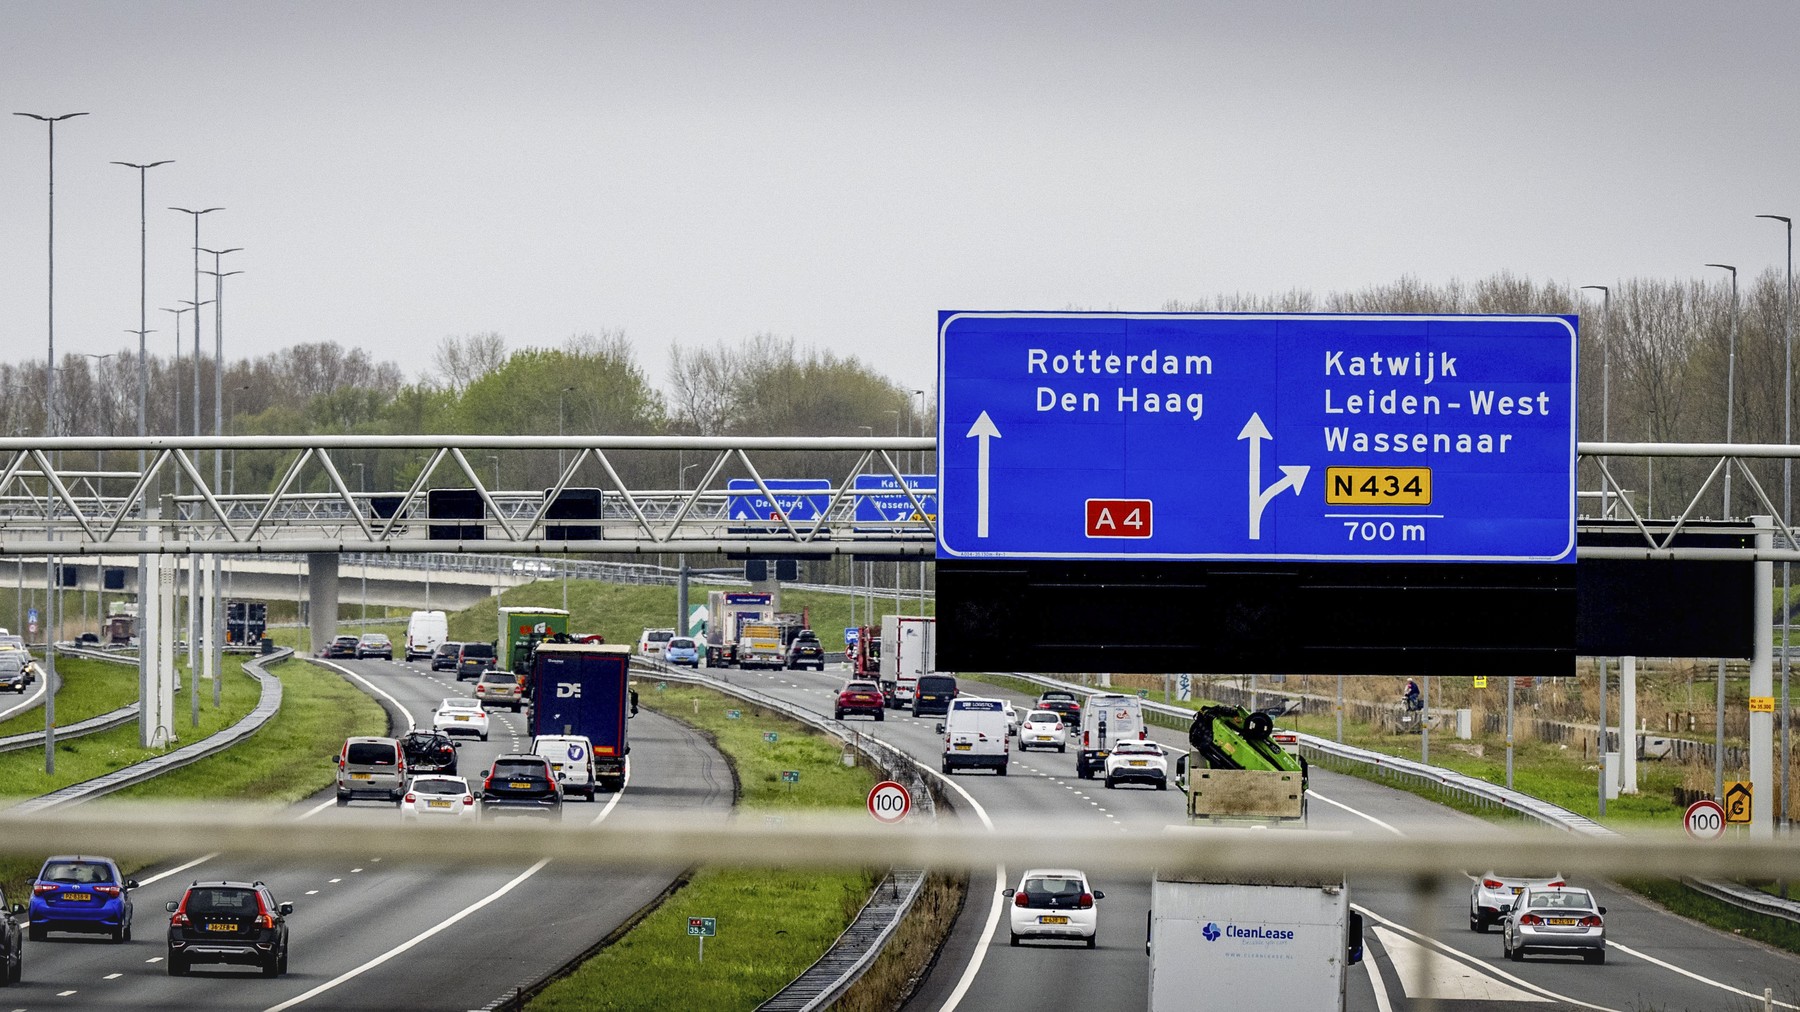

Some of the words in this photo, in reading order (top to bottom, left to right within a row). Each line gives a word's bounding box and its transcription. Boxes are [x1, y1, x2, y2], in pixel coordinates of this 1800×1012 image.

[1028, 349, 1212, 375] Rotterdam
[1325, 351, 1457, 385] Katwijk
[1036, 387, 1100, 412] Den
[1118, 388, 1203, 421] Haag
[1325, 390, 1550, 416] Leiden-West
[1324, 427, 1513, 453] Wassenaar
[881, 480, 919, 489] Katijk
[1344, 522, 1394, 541] 700
[1402, 525, 1426, 541] m
[876, 794, 904, 811] 100
[1732, 800, 1744, 815] G
[1691, 813, 1720, 831] 100
[1226, 925, 1294, 940] CleanLease
